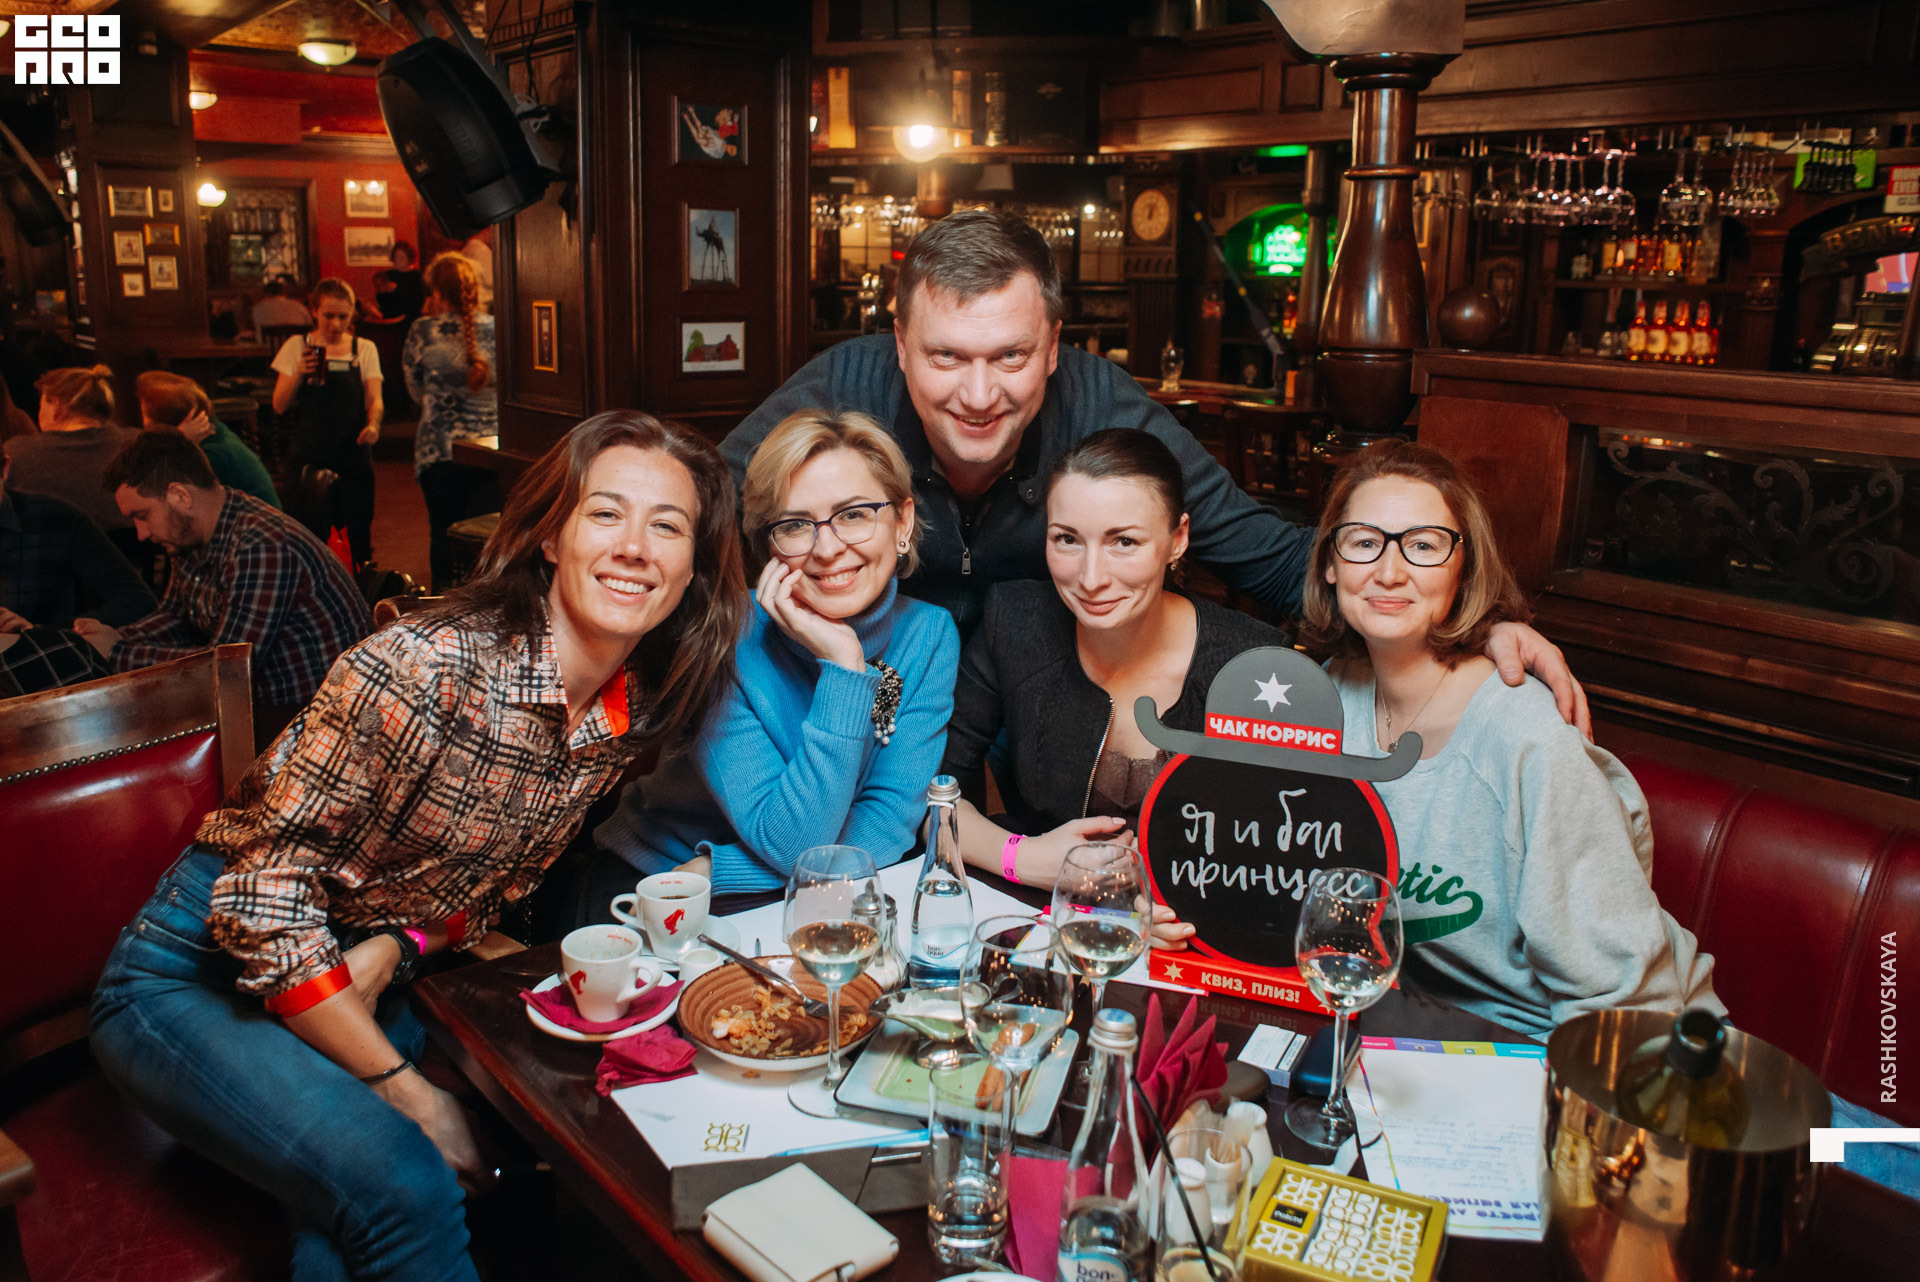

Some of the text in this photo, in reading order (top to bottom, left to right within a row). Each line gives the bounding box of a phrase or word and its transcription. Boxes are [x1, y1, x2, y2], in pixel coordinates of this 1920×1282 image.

[1209, 717, 1336, 750] ЧАК НОРРИС
[1234, 819, 1260, 847] и
[1171, 856, 1369, 901] принцесс
[1201, 971, 1300, 1004] КВИЗ, ПЛИЗ!
